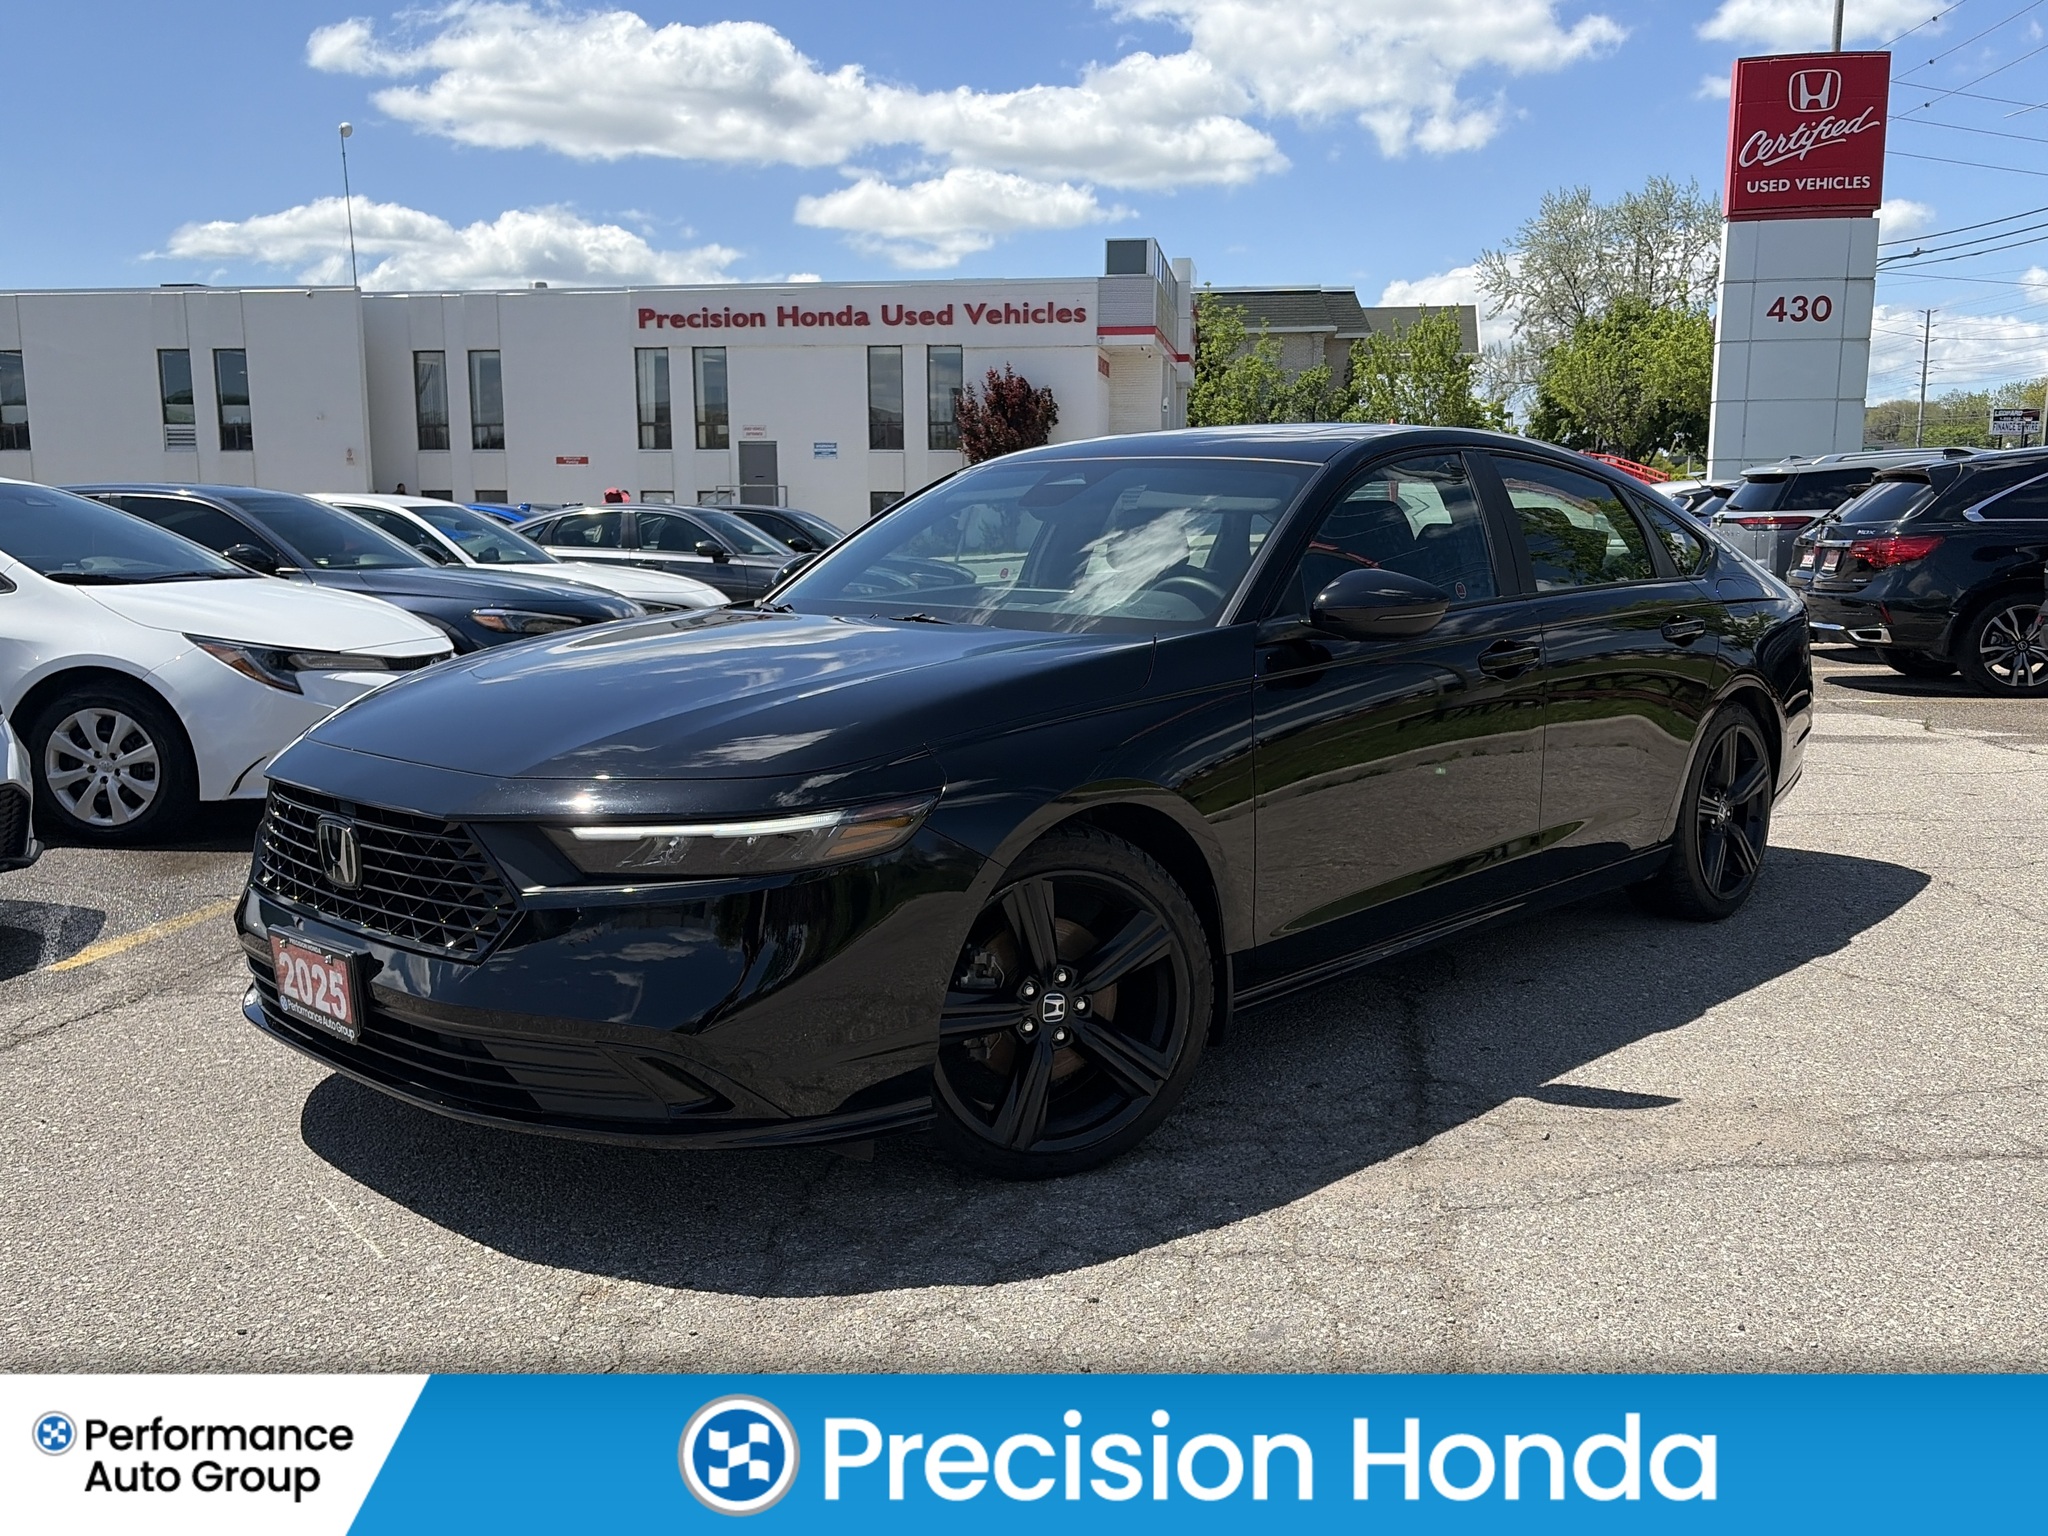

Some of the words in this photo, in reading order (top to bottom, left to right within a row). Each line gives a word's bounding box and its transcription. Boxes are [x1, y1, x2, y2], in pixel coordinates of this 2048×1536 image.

[1739, 106, 1880, 167] Certified
[1746, 179, 1791, 194] USED
[1795, 176, 1871, 191] VEHICLES
[637, 308, 766, 329] Precision
[777, 305, 871, 327] Honda
[881, 303, 954, 326] Used
[963, 302, 1087, 325] Vehicles
[1766, 295, 1833, 322] 430
[279, 952, 347, 1020] 2025
[287, 999, 322, 1025] Performance
[322, 1015, 336, 1031] Auto
[335, 1020, 355, 1041] Group
